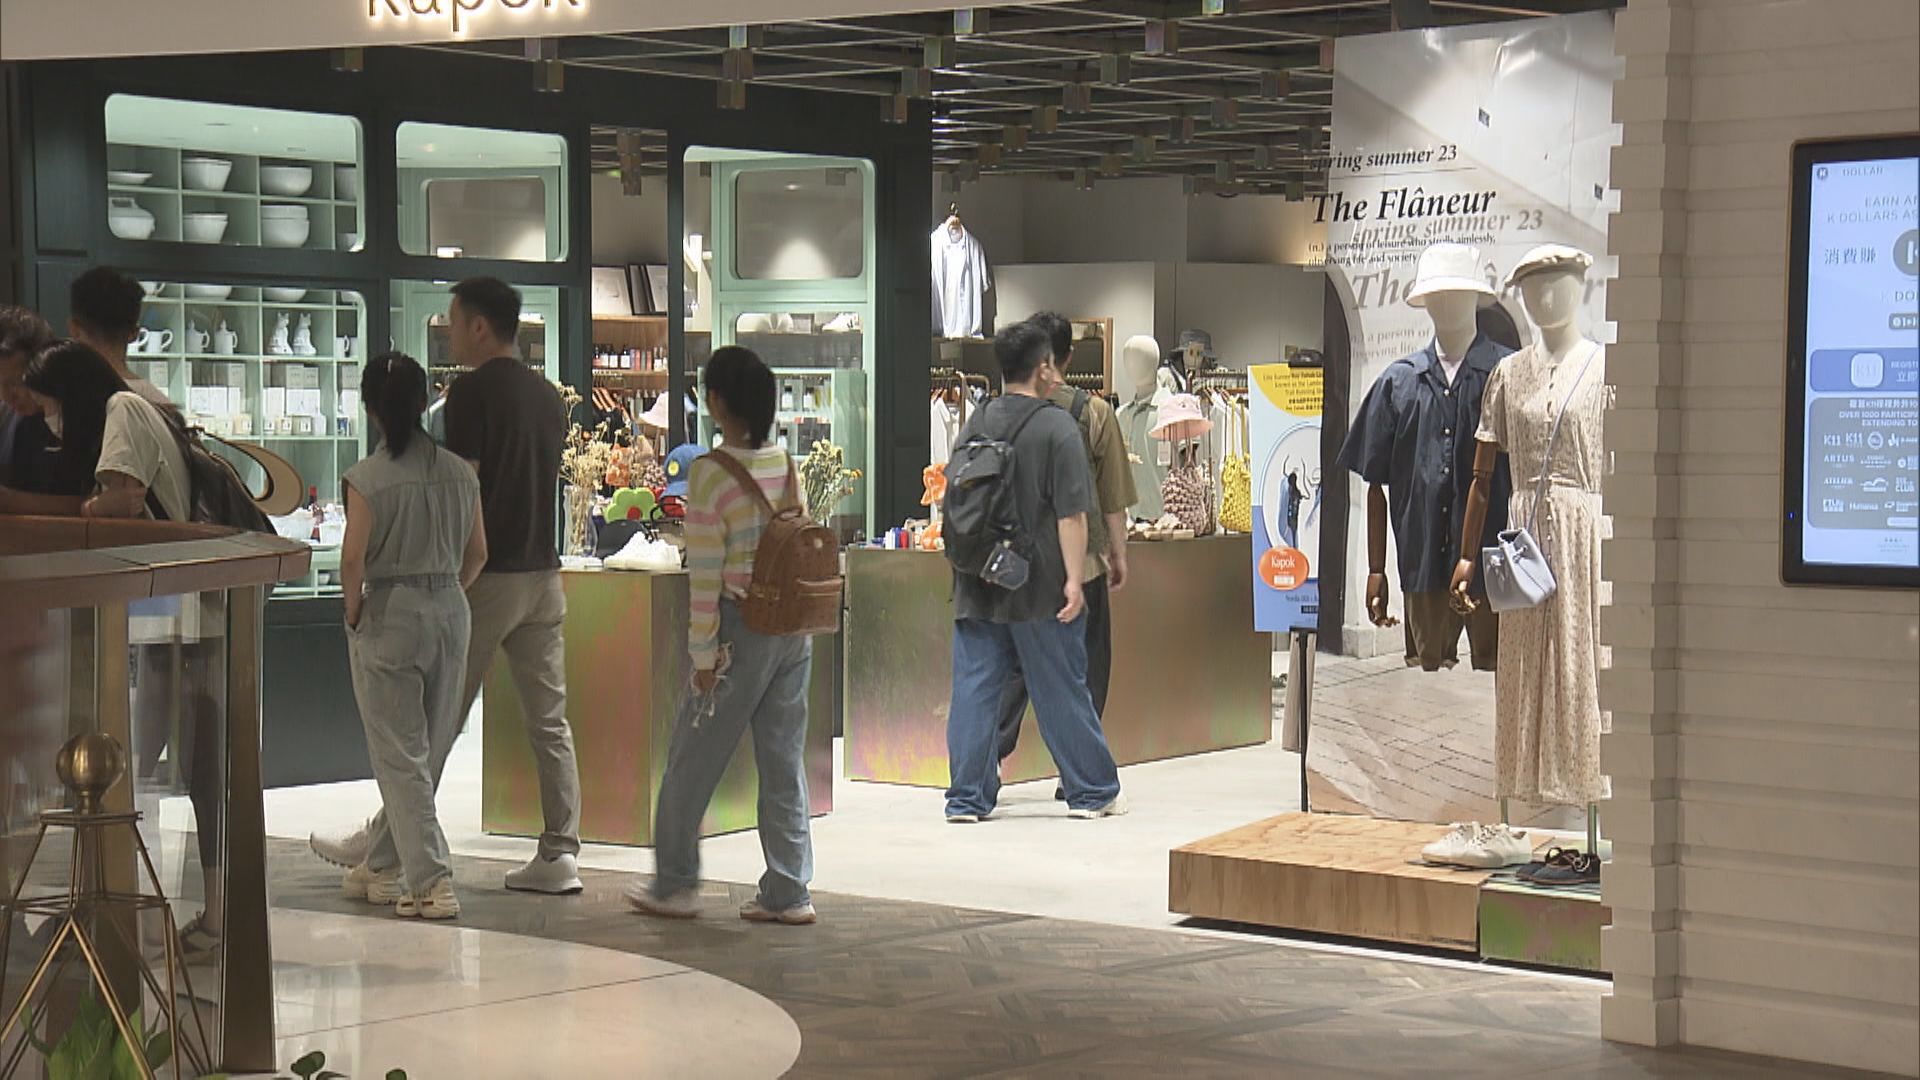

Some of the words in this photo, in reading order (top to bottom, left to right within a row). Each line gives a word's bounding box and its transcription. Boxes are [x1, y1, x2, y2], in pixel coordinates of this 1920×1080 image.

[1310, 152, 1362, 173] spring
[1366, 150, 1434, 167] summer
[1438, 144, 1457, 161] 23
[1312, 191, 1368, 223] The
[1376, 186, 1496, 220] Flâneur
[1840, 209, 1898, 222] DOLLARS
[1424, 214, 1511, 238] summer
[1518, 209, 1544, 231] 23
[1377, 237, 1406, 249] leisure
[1271, 555, 1295, 570] Kapok
